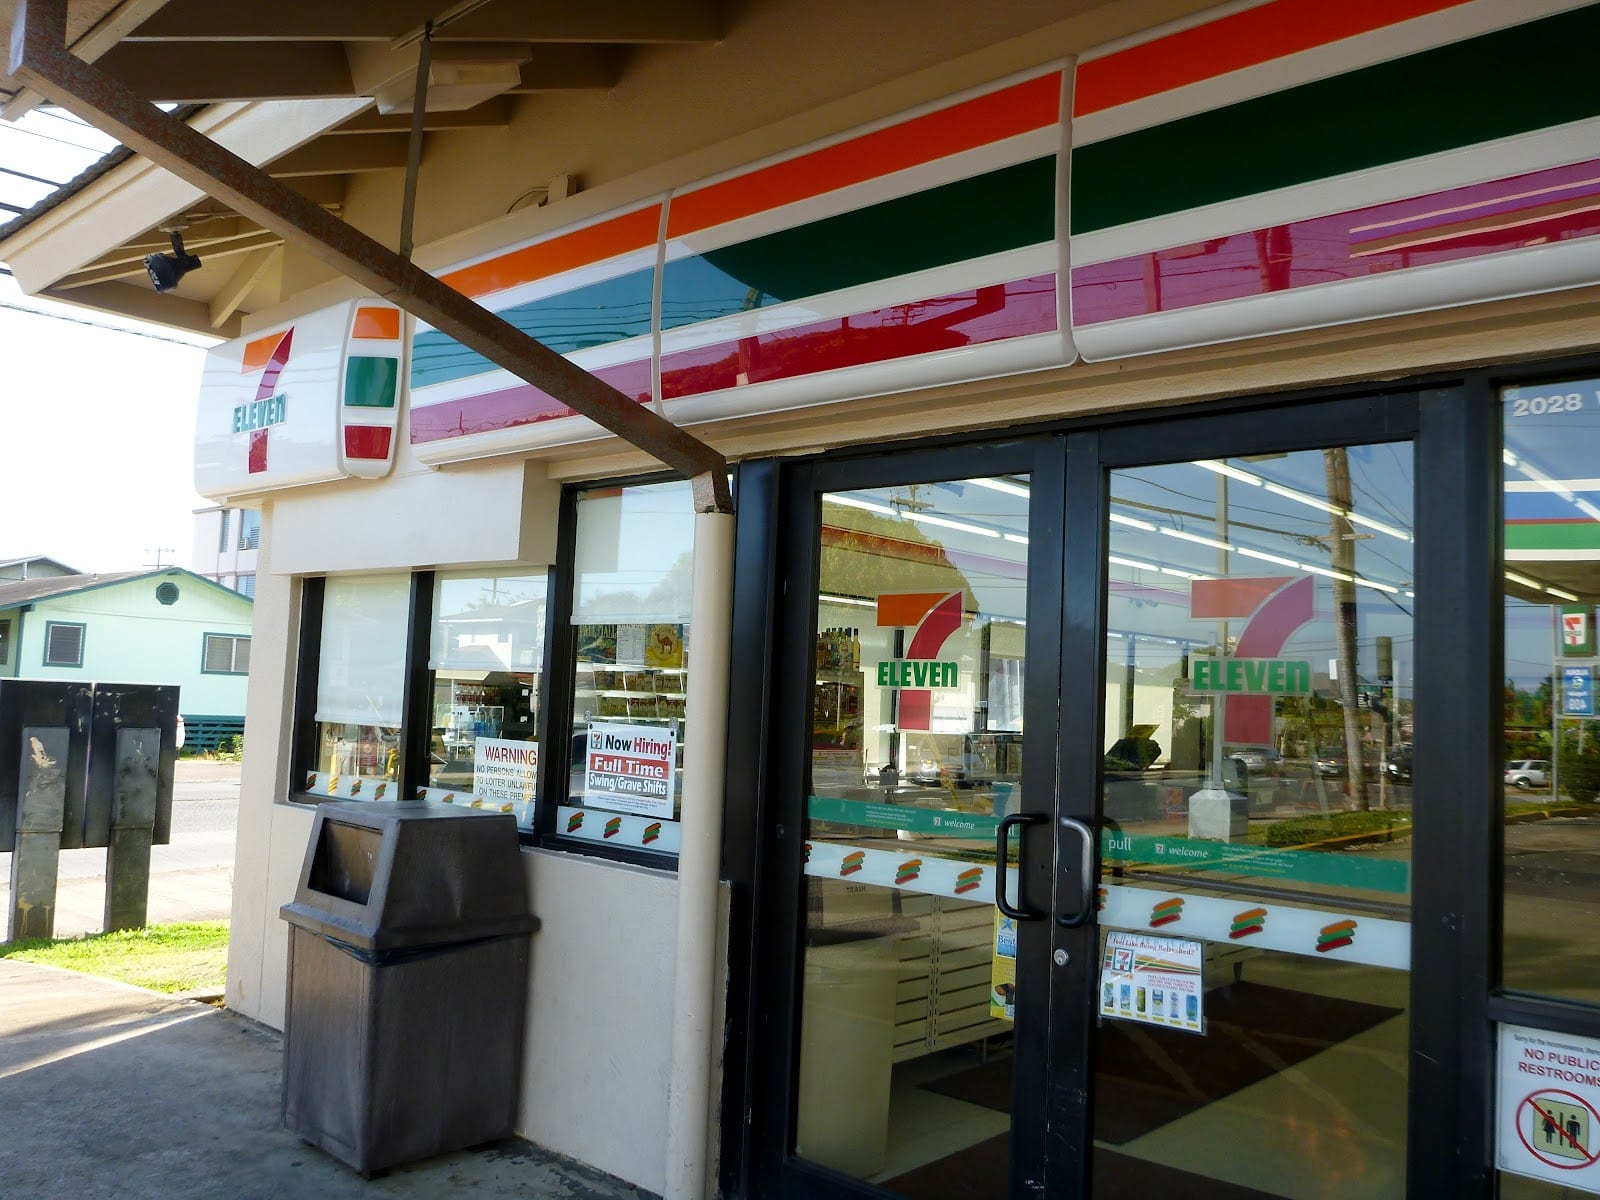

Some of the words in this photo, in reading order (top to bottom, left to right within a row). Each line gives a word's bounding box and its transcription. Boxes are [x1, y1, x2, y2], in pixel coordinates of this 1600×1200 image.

[241, 326, 295, 474] 7
[1513, 393, 1583, 417] 2028
[232, 393, 288, 434] ELEVEN
[877, 591, 963, 731] 7
[1190, 575, 1315, 745] 7
[877, 661, 958, 688] ELEVEN
[1193, 660, 1311, 693] ELEVEN
[485, 745, 537, 766] WARNING
[605, 735, 632, 751] Now
[633, 737, 672, 760] Hiring!
[477, 764, 485, 774] NO
[487, 766, 514, 777] PERSONS
[594, 756, 622, 773] Full
[626, 760, 664, 778] Time
[477, 776, 484, 785] TO
[486, 777, 506, 788] LOITER
[479, 787, 488, 797] ON
[490, 789, 508, 799] THESE
[590, 773, 642, 792] Swing/Grave
[643, 780, 666, 795] Shifts
[944, 819, 975, 830] welcome
[1108, 838, 1132, 852] pull
[1169, 847, 1209, 859] welcome
[1524, 1047, 1545, 1060] NO
[1548, 1052, 1600, 1071] PUBLIC
